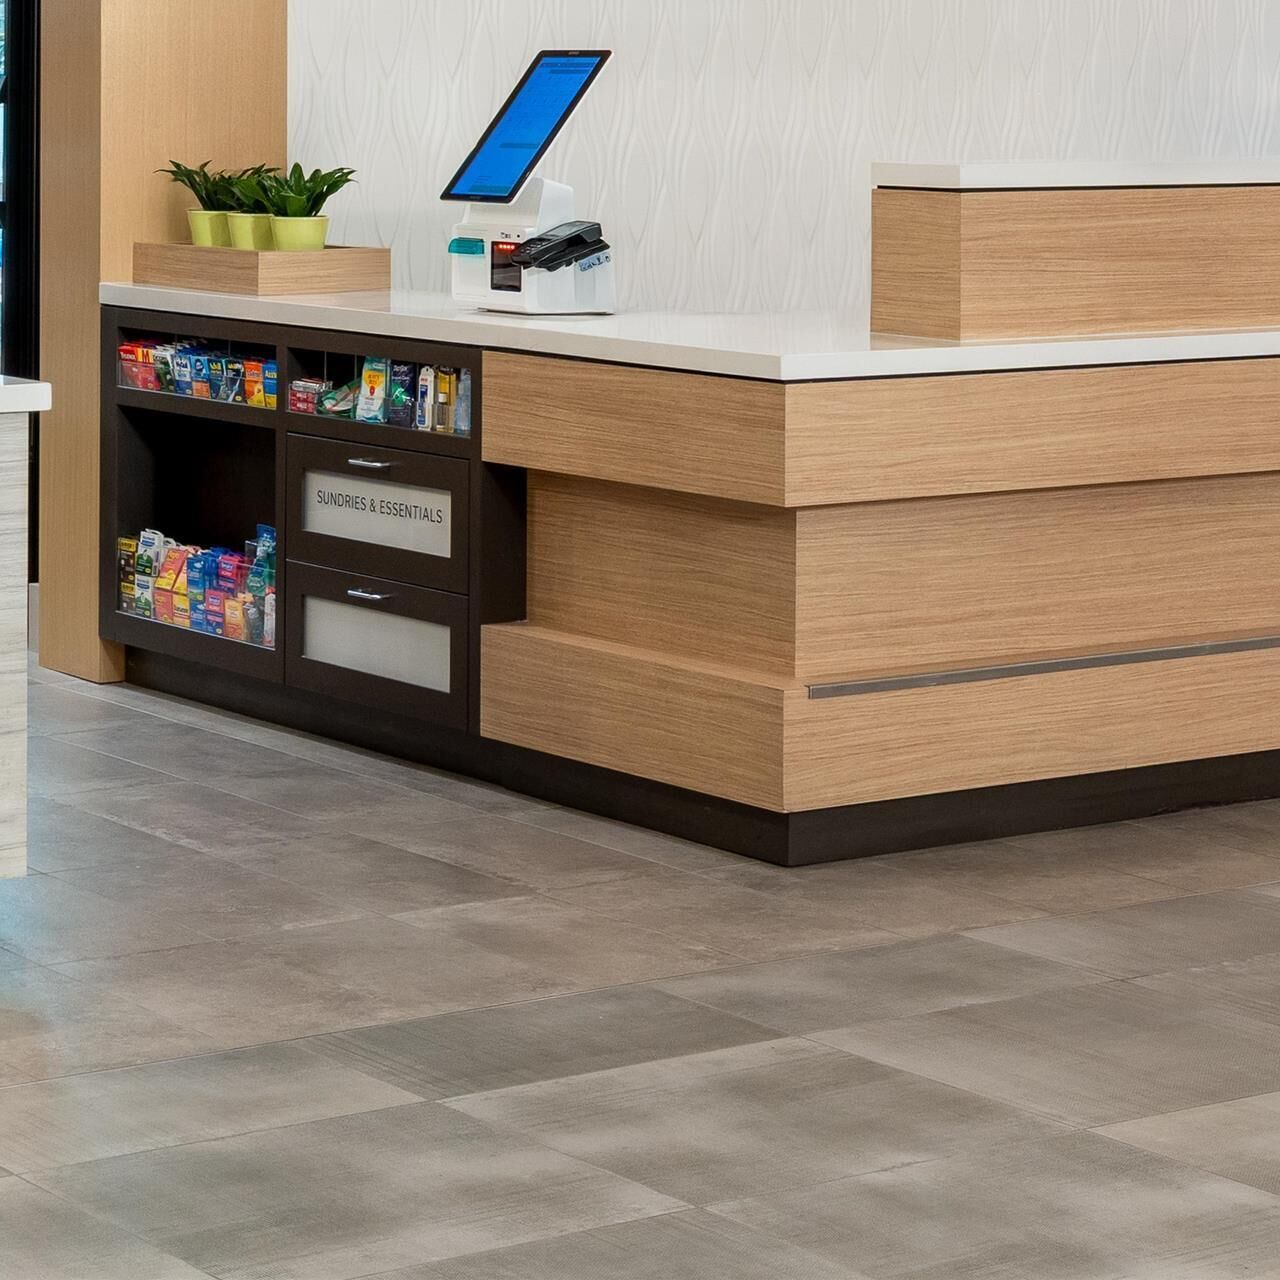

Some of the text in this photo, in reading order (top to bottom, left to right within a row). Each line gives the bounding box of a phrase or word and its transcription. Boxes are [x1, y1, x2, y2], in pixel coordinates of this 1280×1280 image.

[316, 489, 443, 524] SUNDRIES & ESSENTIALS
